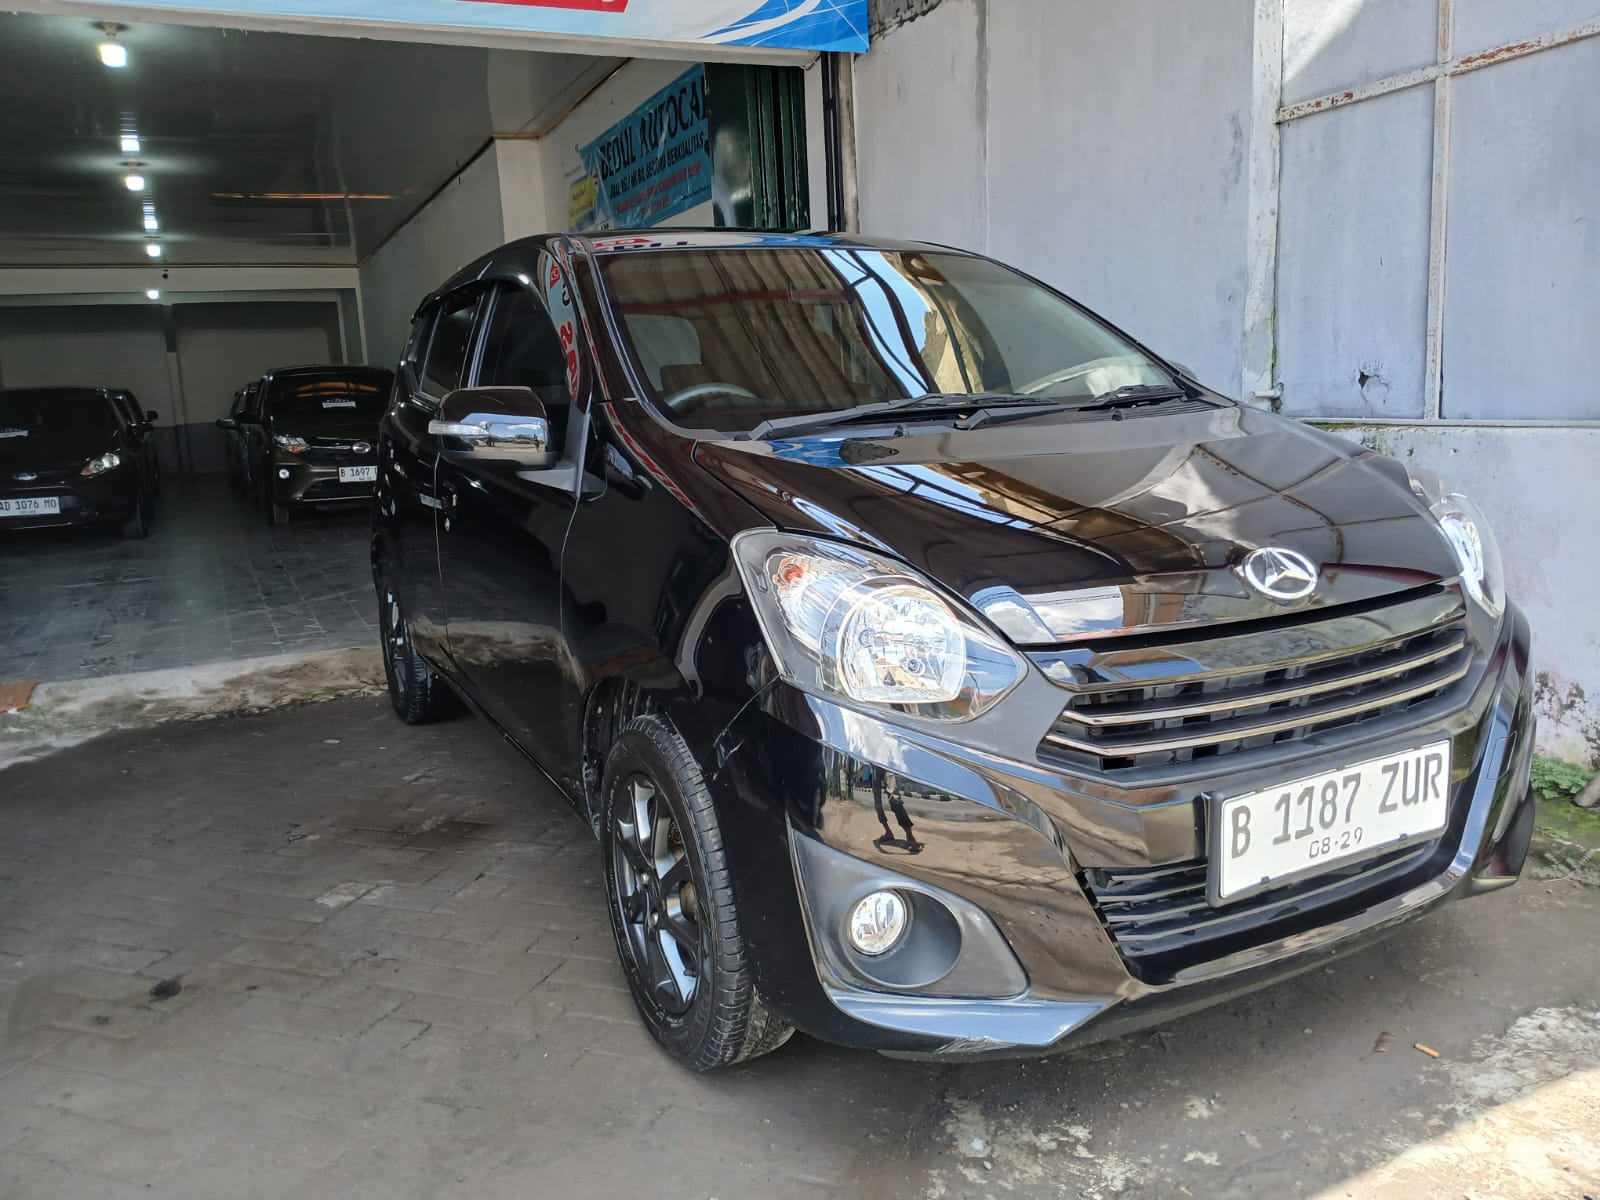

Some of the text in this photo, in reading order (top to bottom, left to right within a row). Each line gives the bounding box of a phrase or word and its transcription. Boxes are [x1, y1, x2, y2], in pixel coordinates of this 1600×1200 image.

[15, 499, 39, 510] 1076
[1231, 752, 1443, 859] B 1187 ZUR
